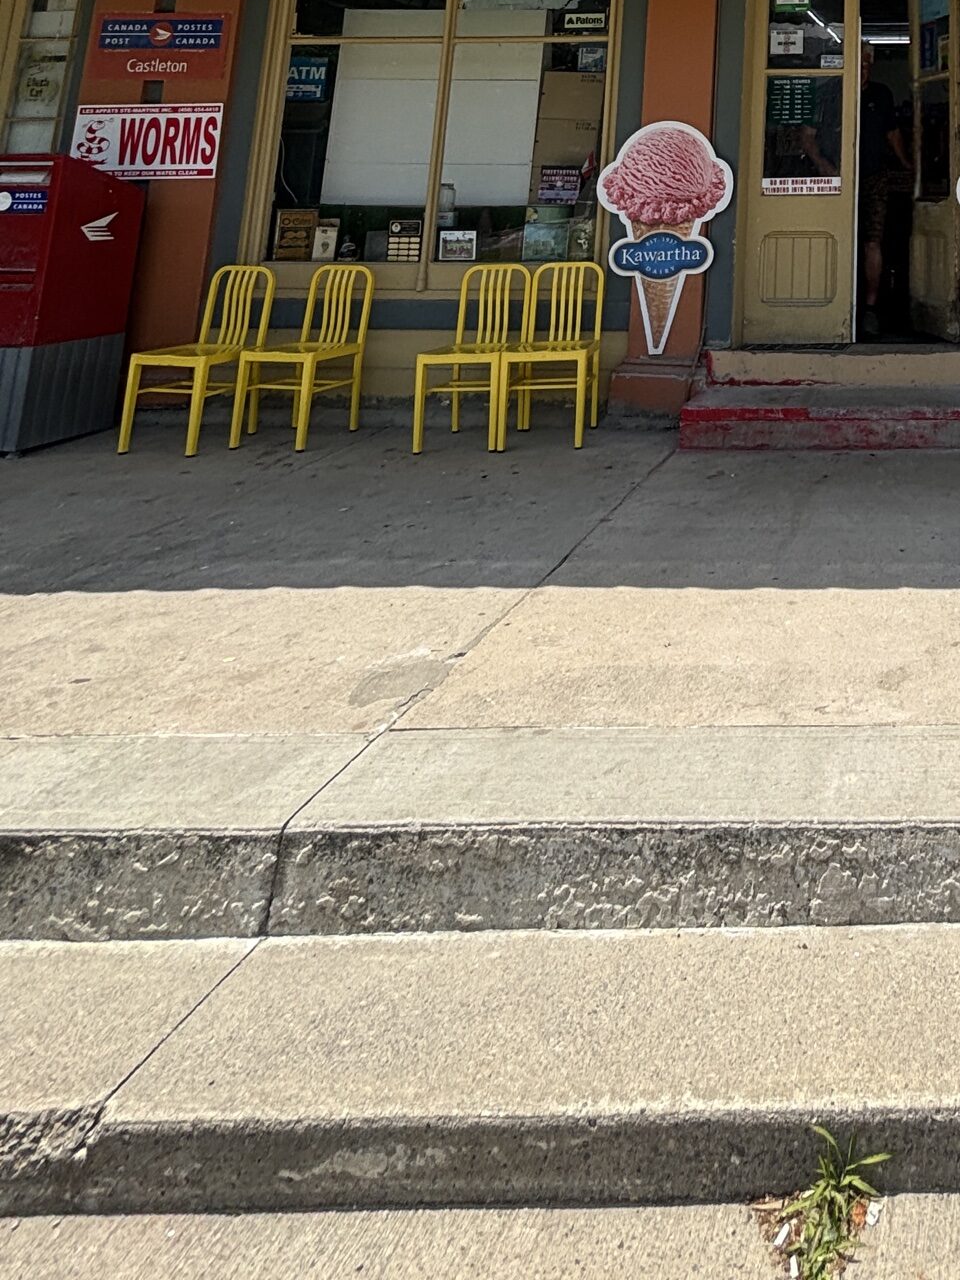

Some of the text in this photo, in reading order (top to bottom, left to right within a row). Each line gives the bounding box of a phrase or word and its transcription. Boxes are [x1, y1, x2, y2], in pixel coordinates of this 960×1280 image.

[575, 16, 603, 25] Patons
[126, 58, 188, 73] Castleton
[288, 66, 326, 80] ATM
[118, 115, 218, 167] WORMS
[621, 246, 700, 266] Kawartha
[645, 265, 675, 275] DAIRY
